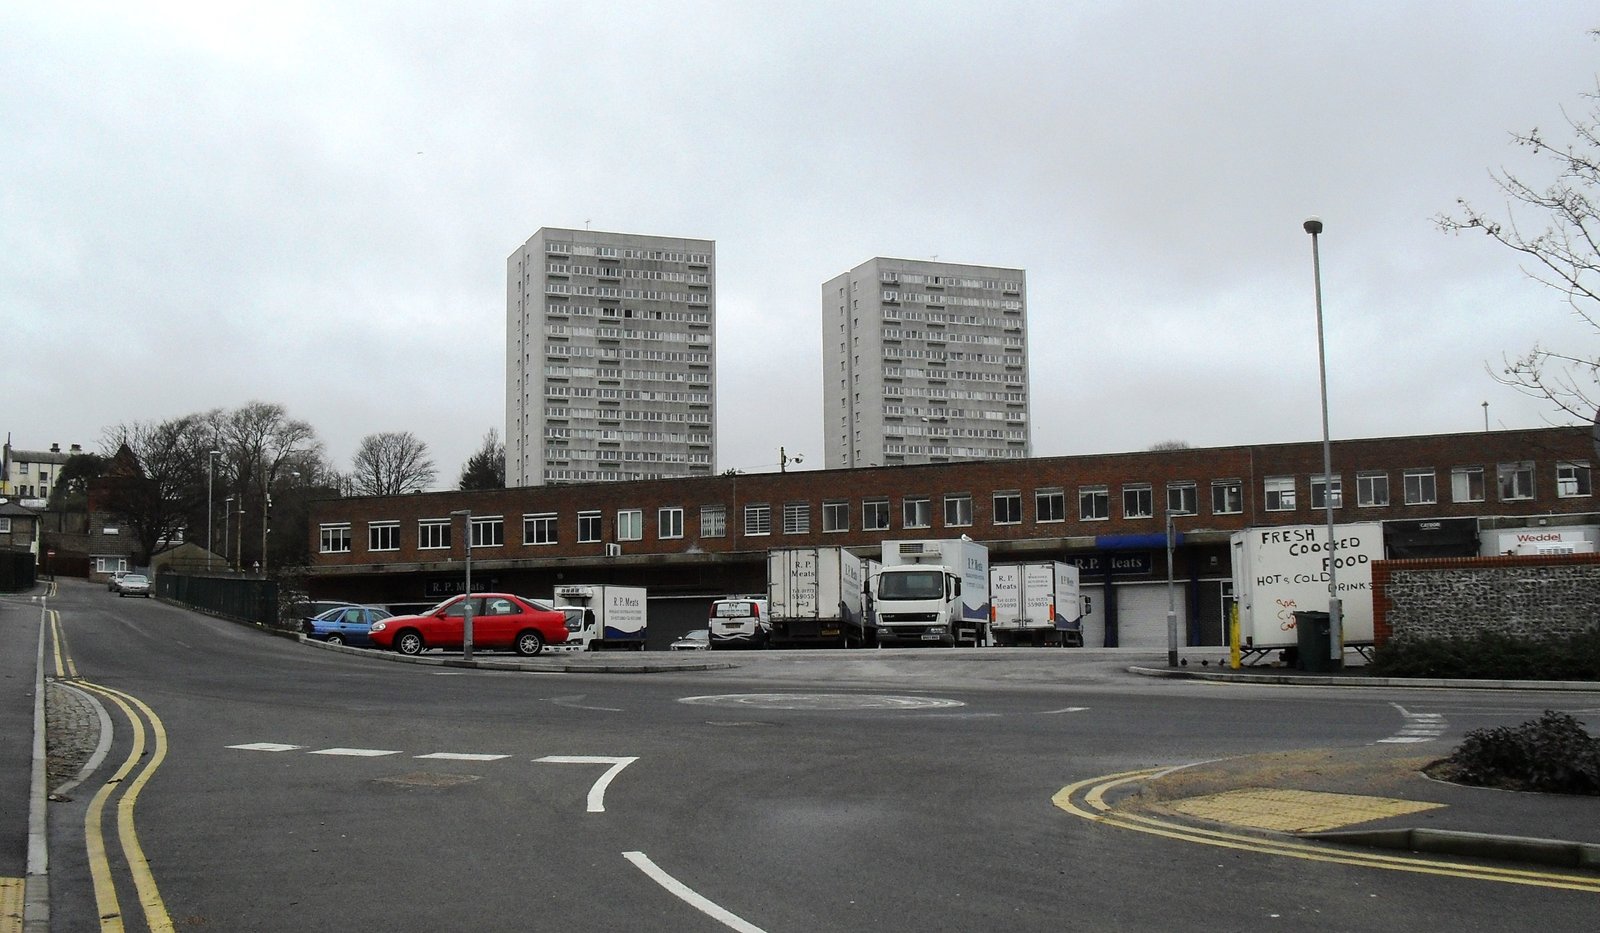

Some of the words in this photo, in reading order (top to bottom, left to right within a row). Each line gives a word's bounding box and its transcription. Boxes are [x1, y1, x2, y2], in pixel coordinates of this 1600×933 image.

[1261, 529, 1315, 544] FRESH
[1516, 533, 1562, 542] Weddel
[1110, 558, 1142, 568] eats
[1322, 554, 1369, 571] FOOD
[1257, 574, 1282, 586] HOT
[1294, 572, 1331, 584] COLD
[456, 582, 485, 591] Mats
[1327, 582, 1374, 593] DRINKS
